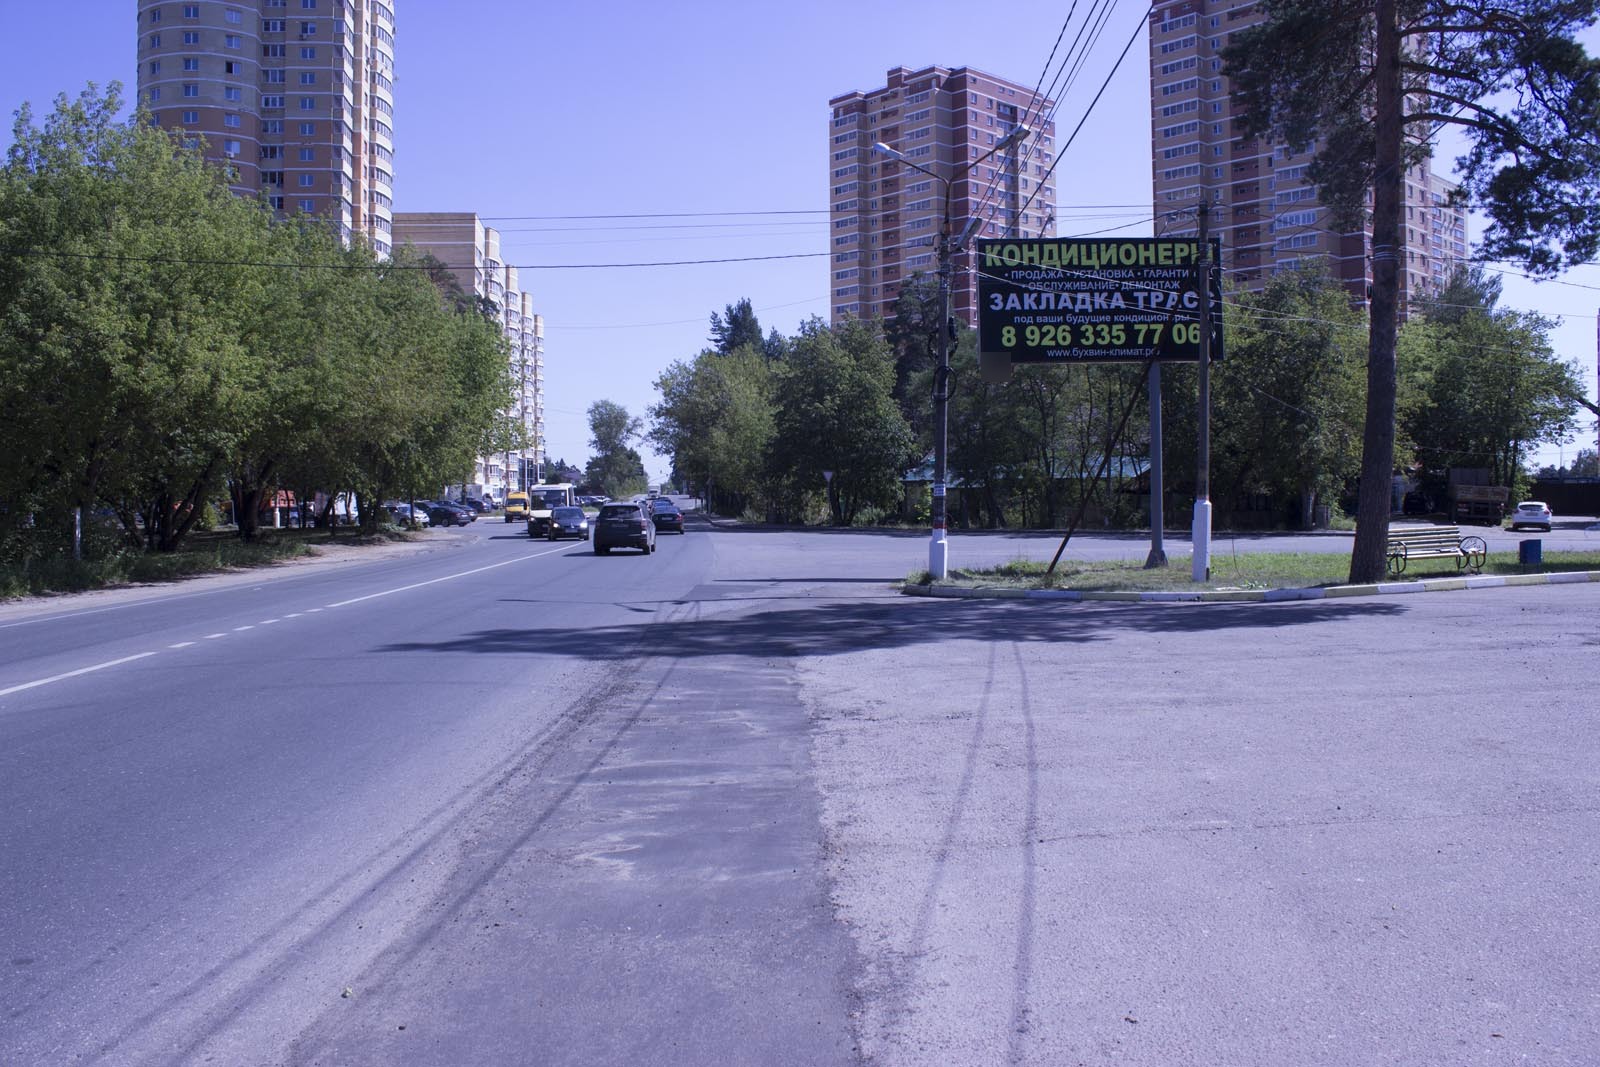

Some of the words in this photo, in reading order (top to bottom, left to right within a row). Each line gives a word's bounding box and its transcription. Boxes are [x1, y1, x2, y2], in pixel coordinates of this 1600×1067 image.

[1011, 270, 1064, 281] ПРОДАЖА
[1073, 269, 1135, 280] УСТАНОВКА
[1028, 281, 1116, 291] ОБСЛУЖИВАНИЕ
[1121, 280, 1181, 291] ДЕМОНТАЖ
[989, 291, 1127, 313] ЗАКЛАДКА
[1014, 315, 1034, 325] под
[1036, 315, 1062, 324] ваши
[1066, 313, 1111, 325] будущие
[1113, 314, 1190, 324] кондиционры
[1002, 325, 1017, 347] 8
[1025, 324, 1072, 347] 926
[1080, 323, 1127, 346] 335
[1133, 323, 1164, 345] 77
[1172, 322, 1201, 345] 06
